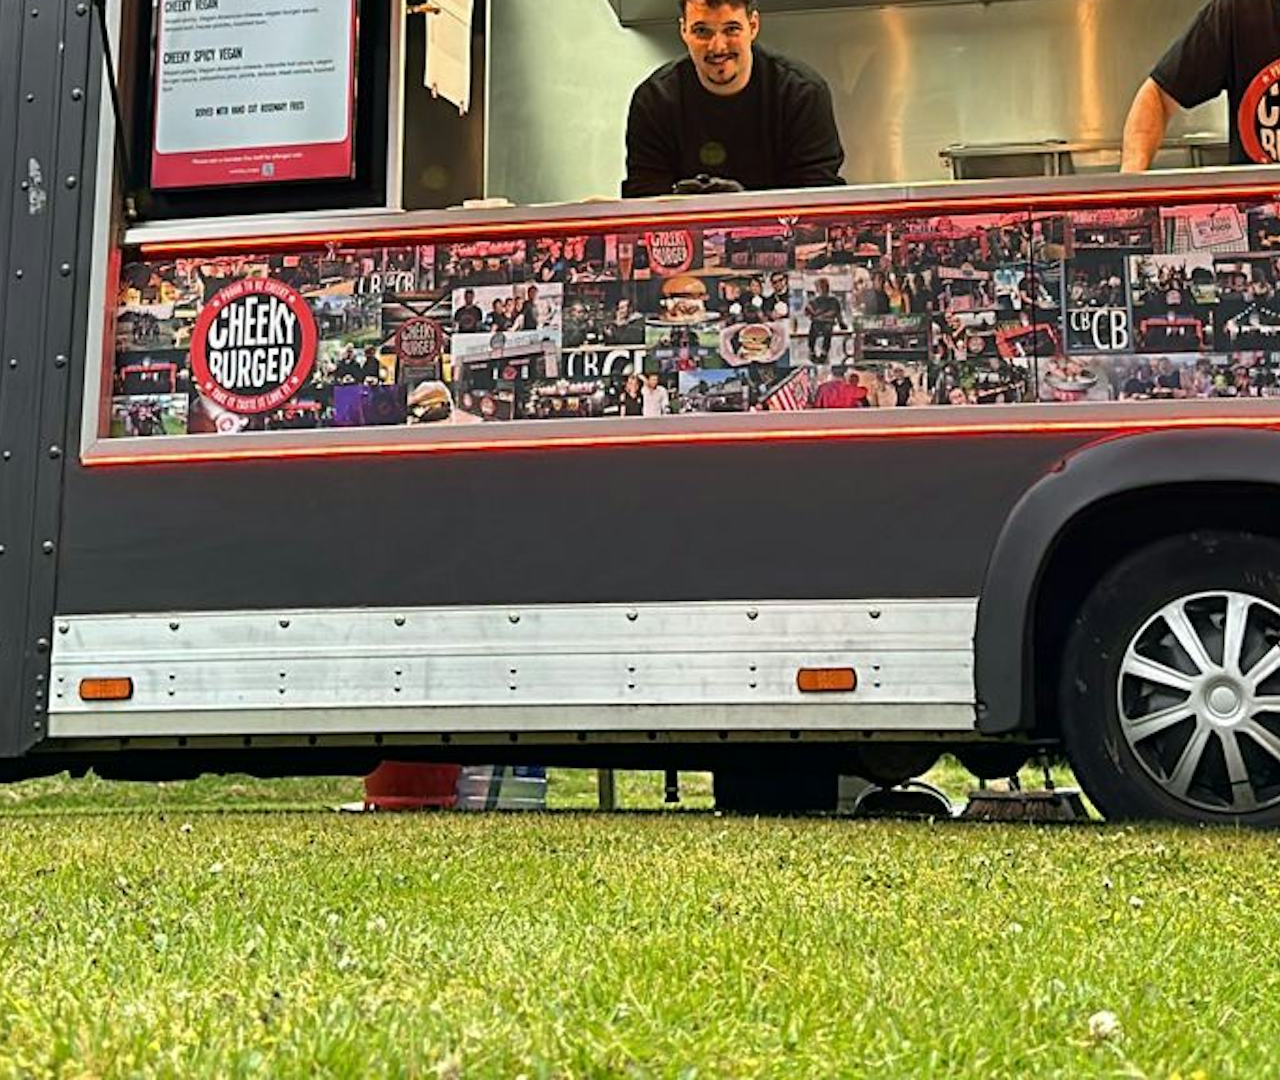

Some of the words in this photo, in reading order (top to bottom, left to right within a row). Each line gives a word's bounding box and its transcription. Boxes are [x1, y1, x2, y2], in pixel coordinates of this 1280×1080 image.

[165, 0, 191, 12] CHEEKY
[163, 51, 190, 64] CHEEKY
[194, 49, 215, 62] SPICY
[219, 47, 243, 60] VEGAN
[208, 296, 296, 349] CHEEKY
[1092, 310, 1129, 350] CB
[209, 346, 295, 389] BURGER
